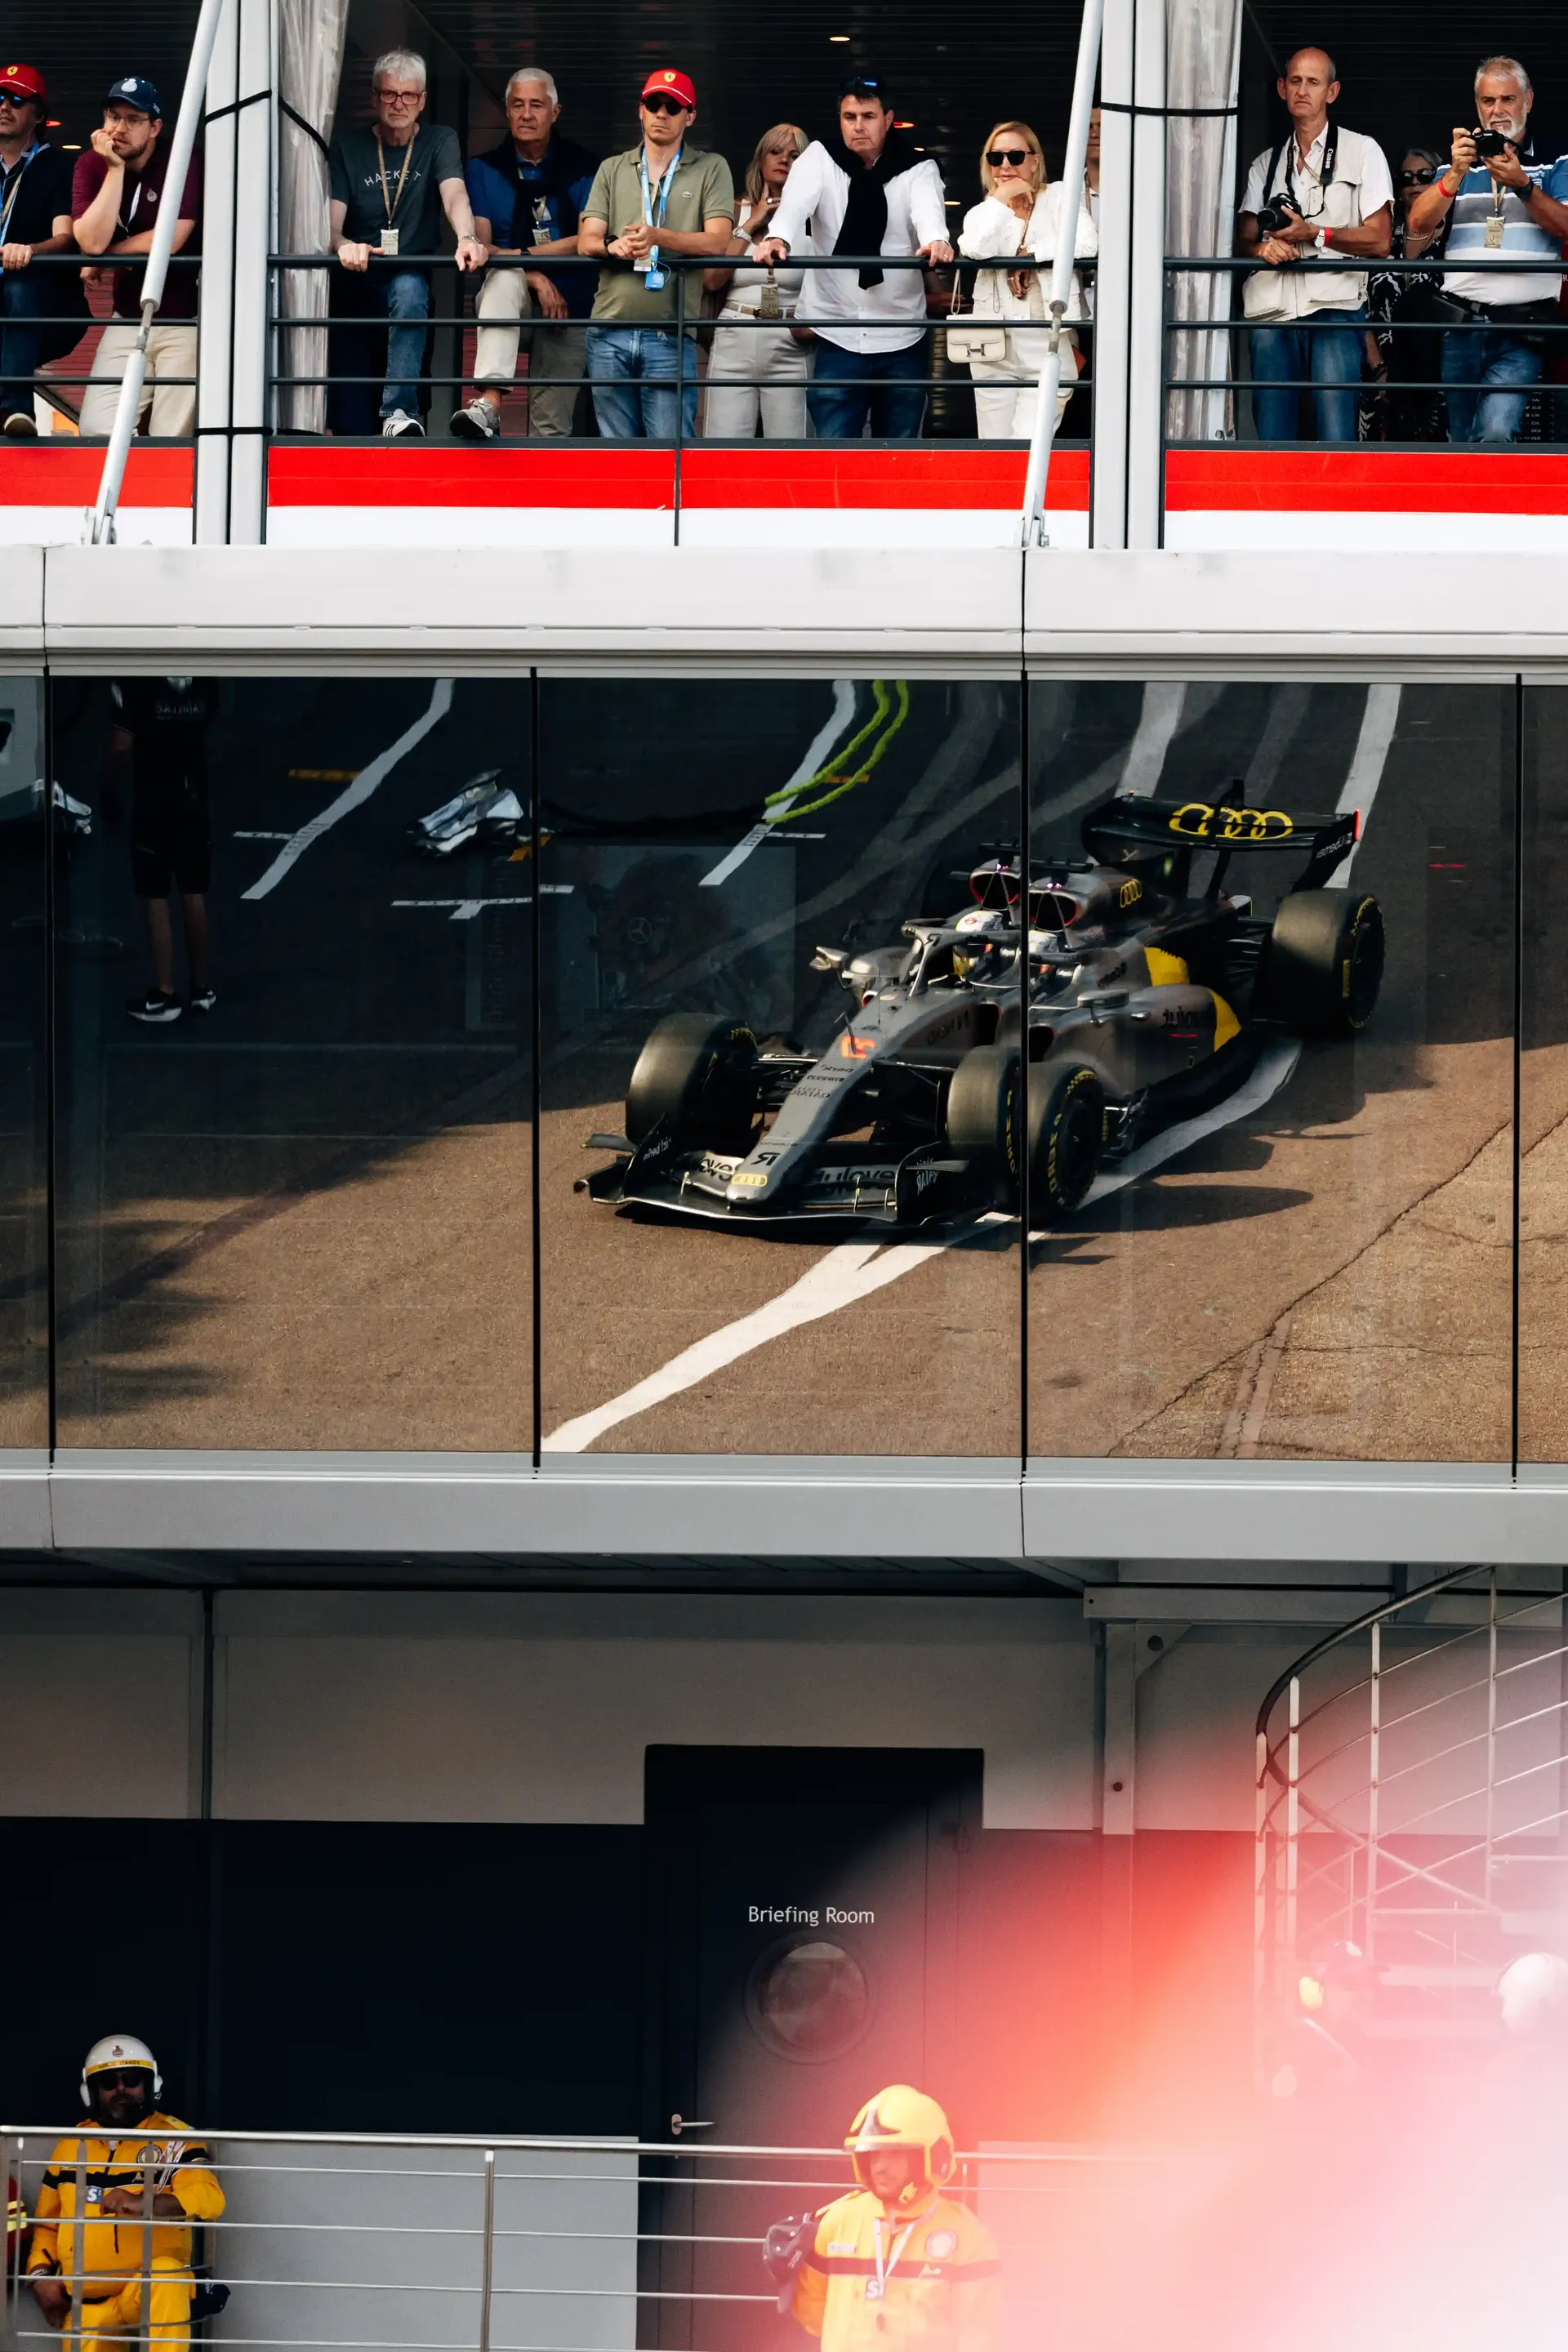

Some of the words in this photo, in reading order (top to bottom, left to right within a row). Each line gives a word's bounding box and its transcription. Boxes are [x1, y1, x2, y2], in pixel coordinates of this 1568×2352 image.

[1325, 148, 1334, 169] Canon
[748, 1905, 819, 1927] Briefing
[826, 1907, 875, 1923] Room
